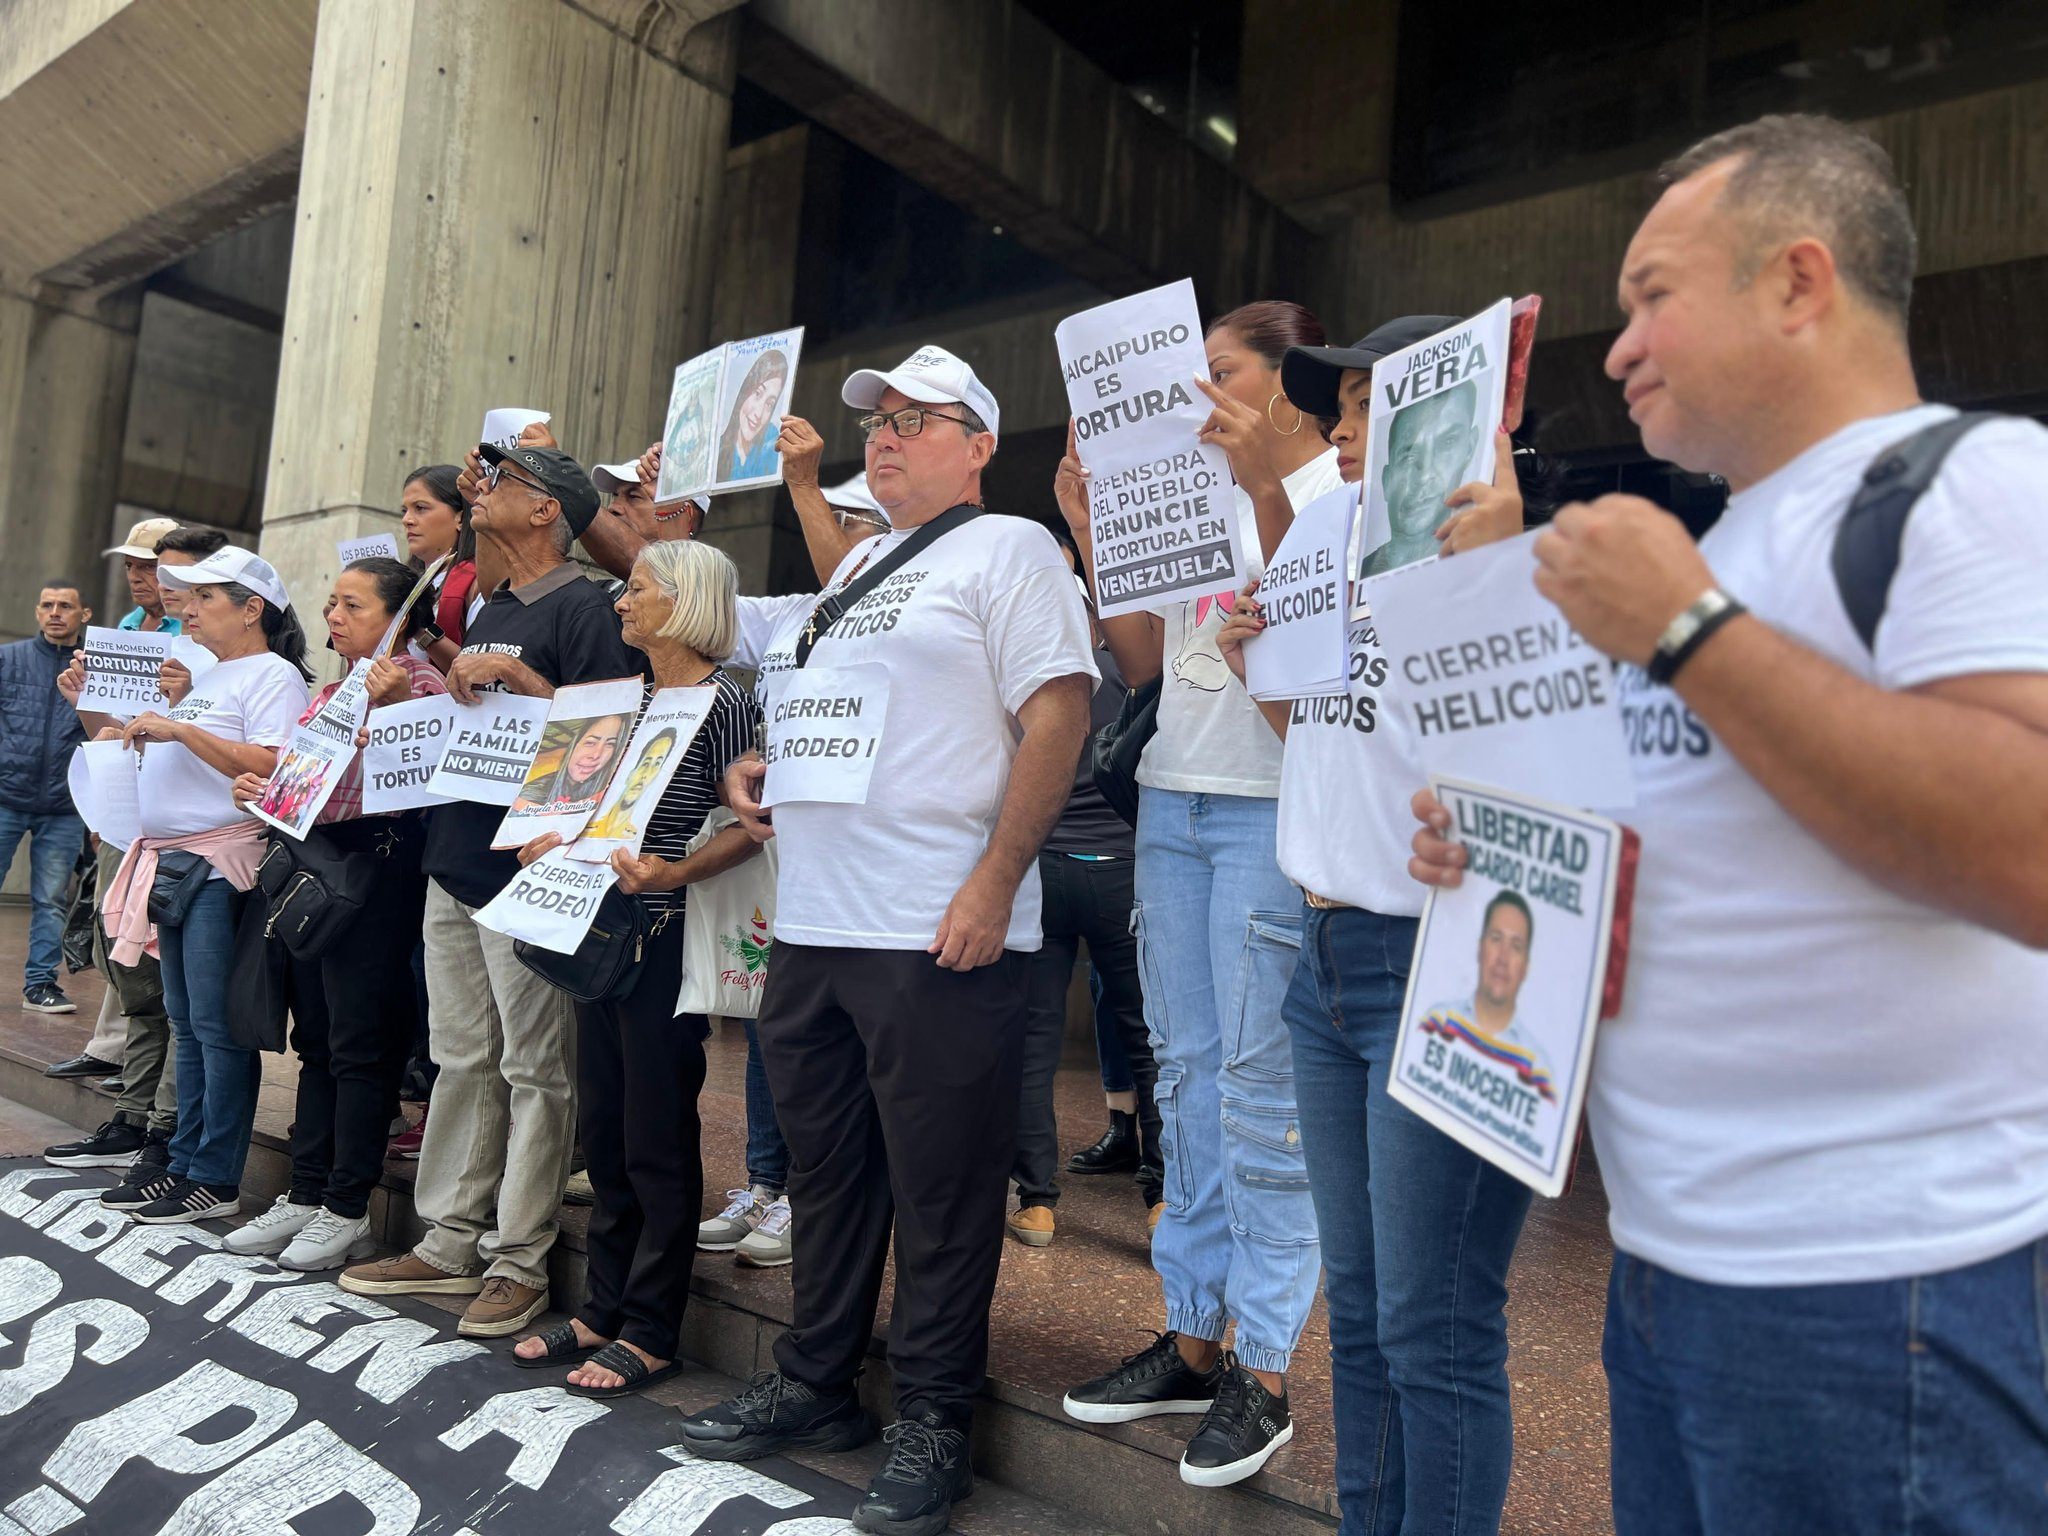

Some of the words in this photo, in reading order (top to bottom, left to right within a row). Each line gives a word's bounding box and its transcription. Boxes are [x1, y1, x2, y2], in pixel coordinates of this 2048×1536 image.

[1405, 329, 1472, 375] JACKSON
[1094, 373, 1122, 399] ES
[1385, 342, 1488, 410] VERA
[1094, 449, 1206, 498] DEFENSORA
[1093, 499, 1115, 520] DEL
[1117, 471, 1218, 511] PUEBLO:
[1096, 495, 1210, 544] DENUNCIE
[342, 549, 354, 561] LOS
[354, 544, 389, 559] PRESOS
[1095, 549, 1109, 567] LA
[1109, 528, 1193, 563] TORTURA
[1197, 518, 1227, 541] EN
[884, 571, 929, 589] TODOS
[1099, 550, 1231, 599] VENEZUELA
[1256, 554, 1311, 594] ERREN
[1315, 548, 1335, 574] EL
[854, 586, 916, 612] RESOS
[1257, 581, 1336, 630] ELICOIDE
[86, 640, 95, 648] EN
[96, 641, 114, 651] ESTE
[115, 643, 164, 654] MOMENTO
[1403, 619, 1560, 686] CIERREN
[85, 654, 162, 674] TORTURAN
[88, 673, 96, 681] A
[102, 674, 117, 683] UN
[86, 685, 163, 703] POLÍTICO
[1413, 662, 1608, 737] HELICOIDE
[774, 696, 863, 723] CIERREN
[371, 718, 443, 748] RODEO
[492, 716, 532, 735] LAS
[401, 746, 421, 763] ES
[457, 730, 540, 755] FAMILIA
[767, 743, 778, 766] EL
[782, 737, 860, 760] RODEO
[866, 738, 876, 758] I
[372, 764, 438, 790] TORTU
[445, 755, 473, 771] NO
[474, 760, 530, 780] MIENT
[1456, 797, 1590, 875] LIBERTAD
[530, 861, 593, 889] CIERREN
[591, 873, 605, 889] EL
[508, 880, 587, 919] RODEO
[585, 897, 596, 920] I
[1528, 865, 1584, 917] CARIEL
[720, 969, 750, 991] Feliz
[1423, 1038, 1447, 1072] ES
[1448, 1050, 1540, 1127] INOCENTE
[0, 1168, 492, 1404] LIBEREN
[437, 1386, 613, 1491] A
